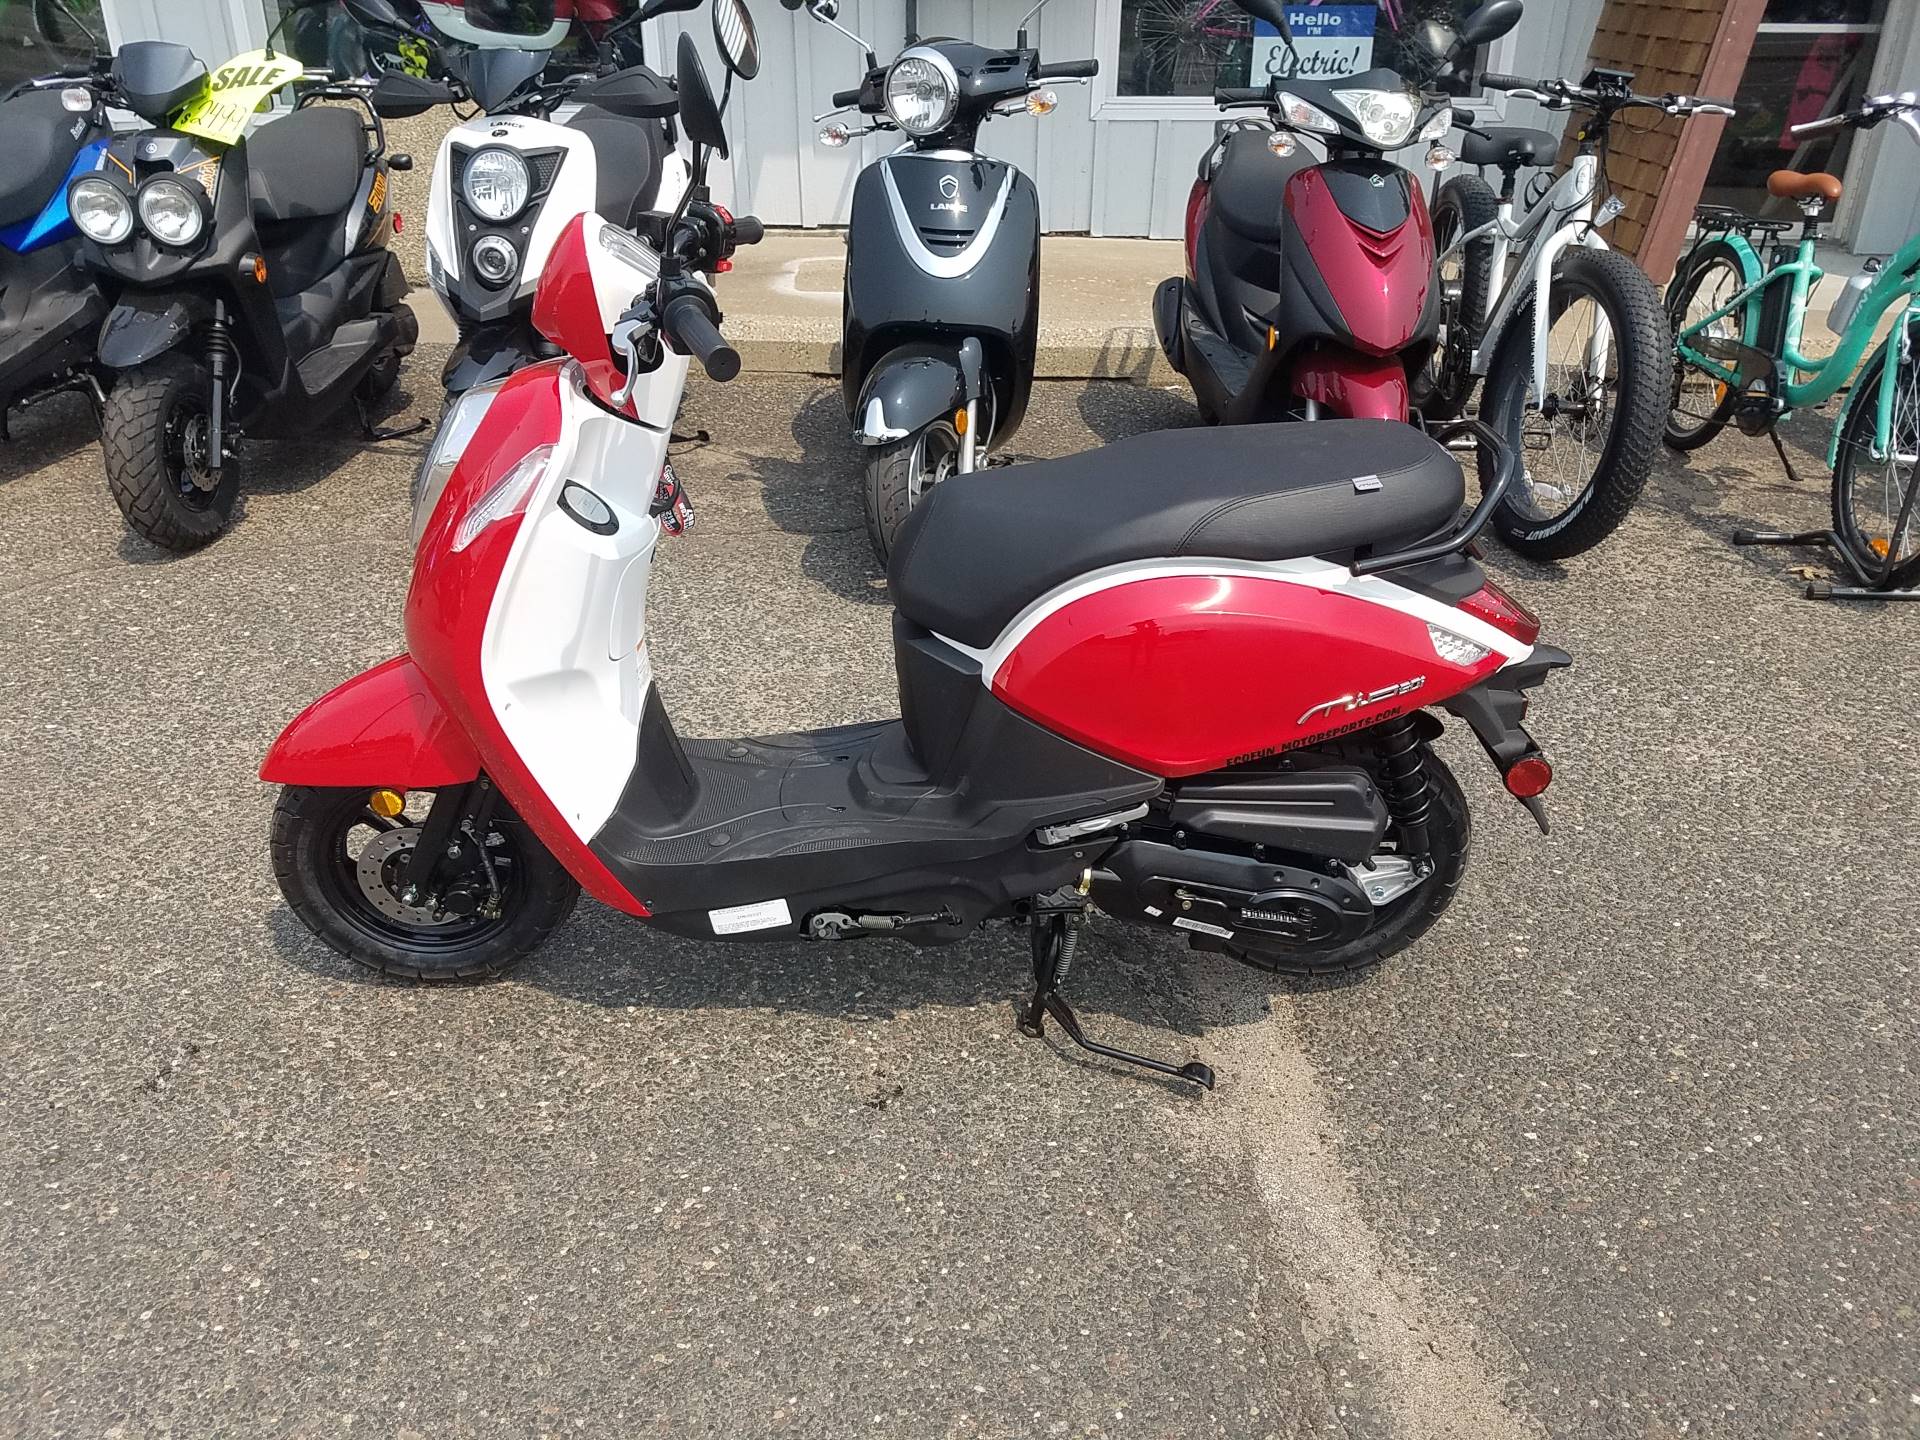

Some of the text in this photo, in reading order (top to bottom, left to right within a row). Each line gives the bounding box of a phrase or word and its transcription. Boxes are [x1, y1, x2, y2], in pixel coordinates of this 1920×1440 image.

[1289, 12, 1342, 26] Hello
[1306, 26, 1322, 36] I'M
[1265, 45, 1360, 75] Elctric!
[211, 66, 286, 92] SALE
[930, 203, 968, 213] LANE
[1516, 292, 1534, 316] KEND
[1226, 705, 1404, 767] ECOFUN MOTORSPORTS.COM
